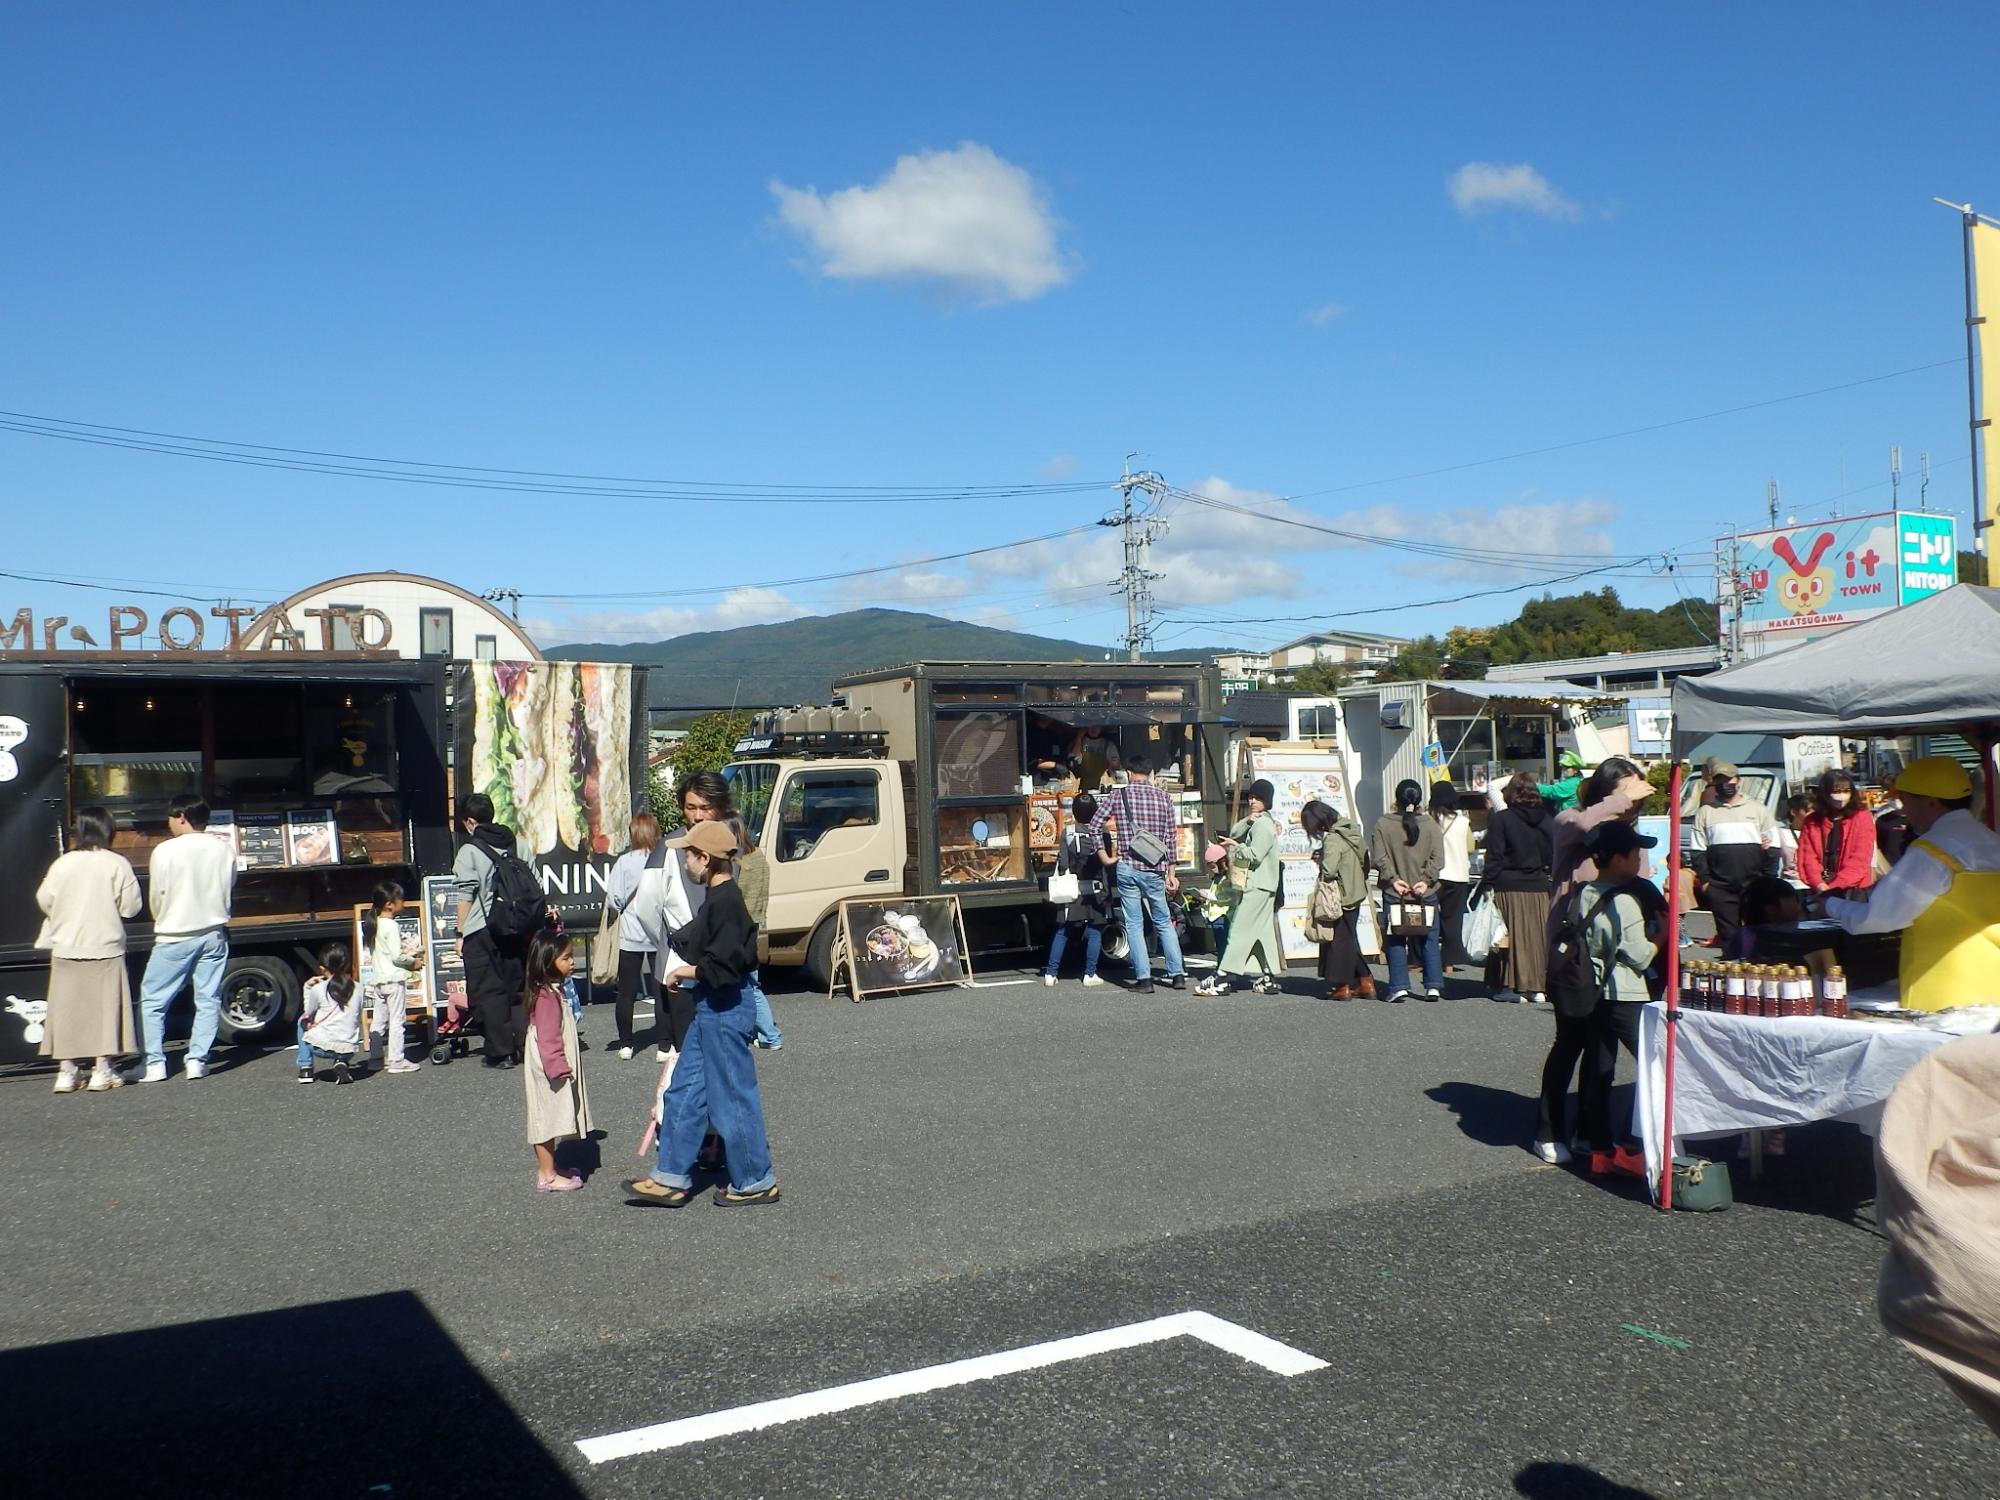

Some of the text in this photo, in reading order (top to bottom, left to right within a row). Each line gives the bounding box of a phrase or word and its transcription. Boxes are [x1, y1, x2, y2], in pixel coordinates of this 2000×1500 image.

[1904, 531, 1951, 566] ニトリ
[1840, 583, 1881, 597] TOWN
[110, 606, 393, 650] POTATO
[1768, 614, 1844, 629] NAKATSUGAWA
